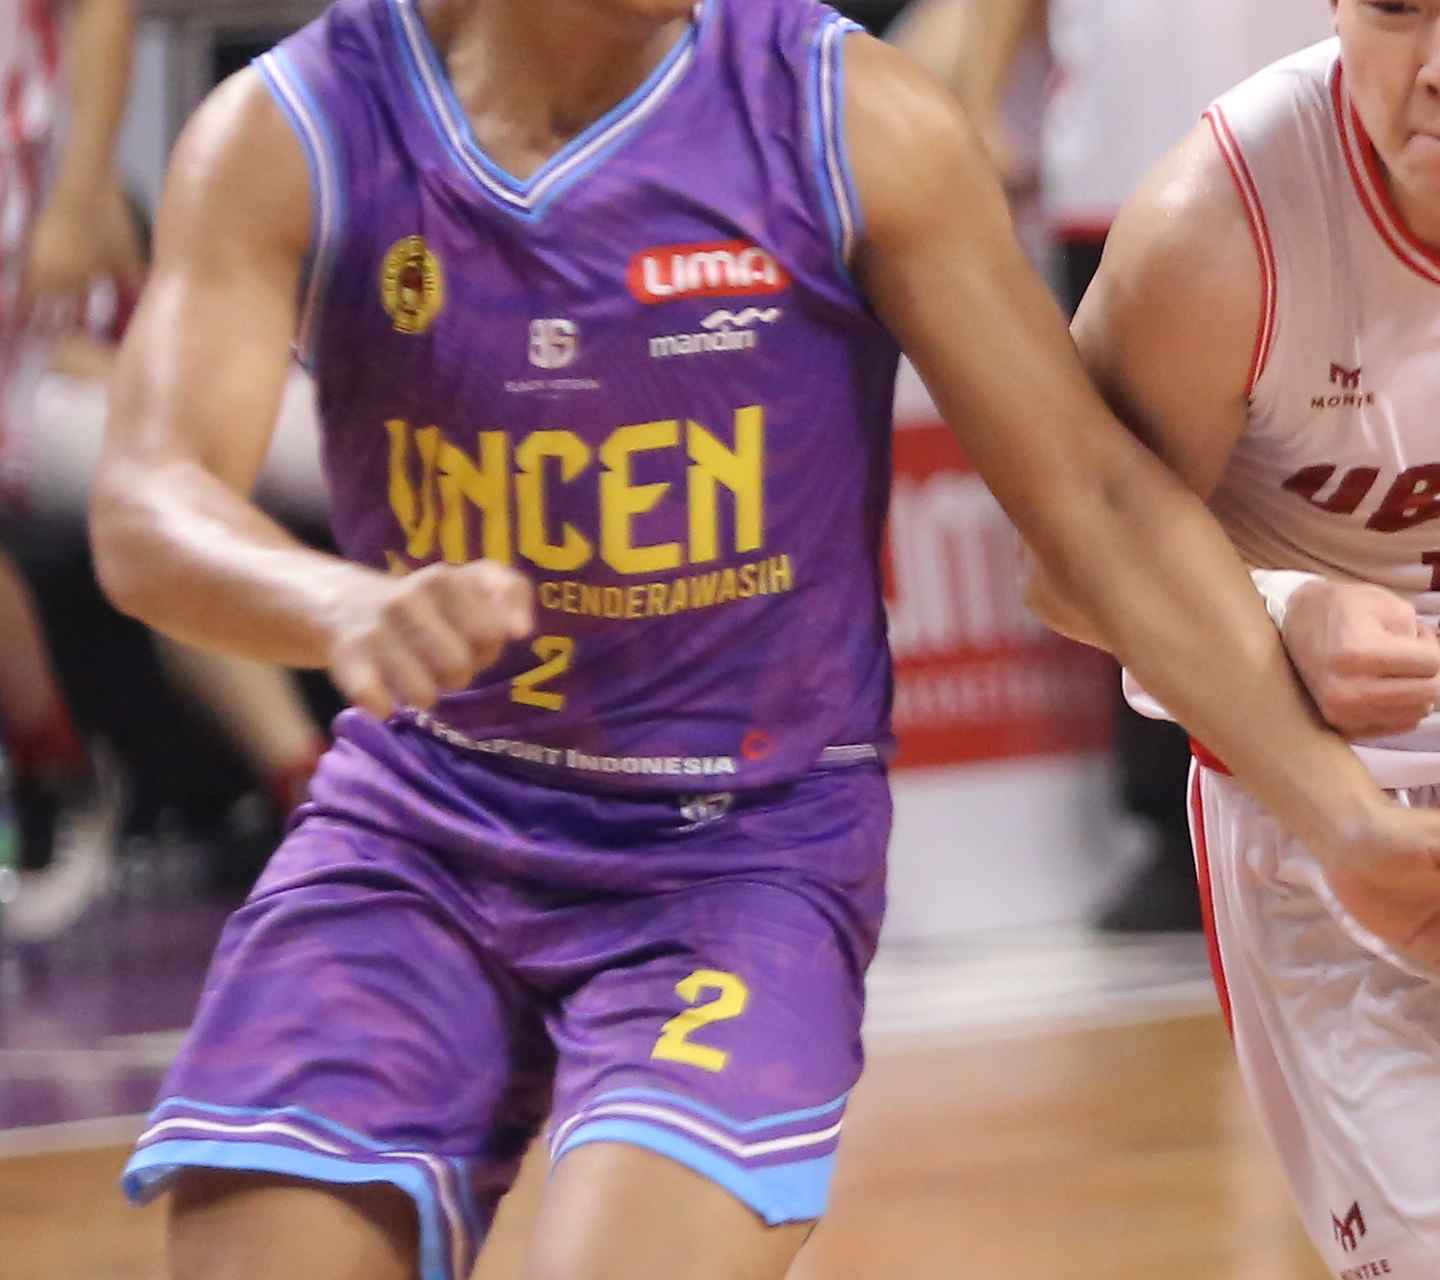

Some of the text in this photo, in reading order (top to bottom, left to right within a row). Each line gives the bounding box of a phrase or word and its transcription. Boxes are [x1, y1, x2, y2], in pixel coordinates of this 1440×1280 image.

[641, 246, 781, 297] LIMA
[384, 404, 765, 576] UNCEN
[538, 554, 793, 619] CENDERAWASIH
[510, 635, 573, 712] 2
[565, 718, 737, 775] INDONESIA
[649, 968, 750, 1074] 2
